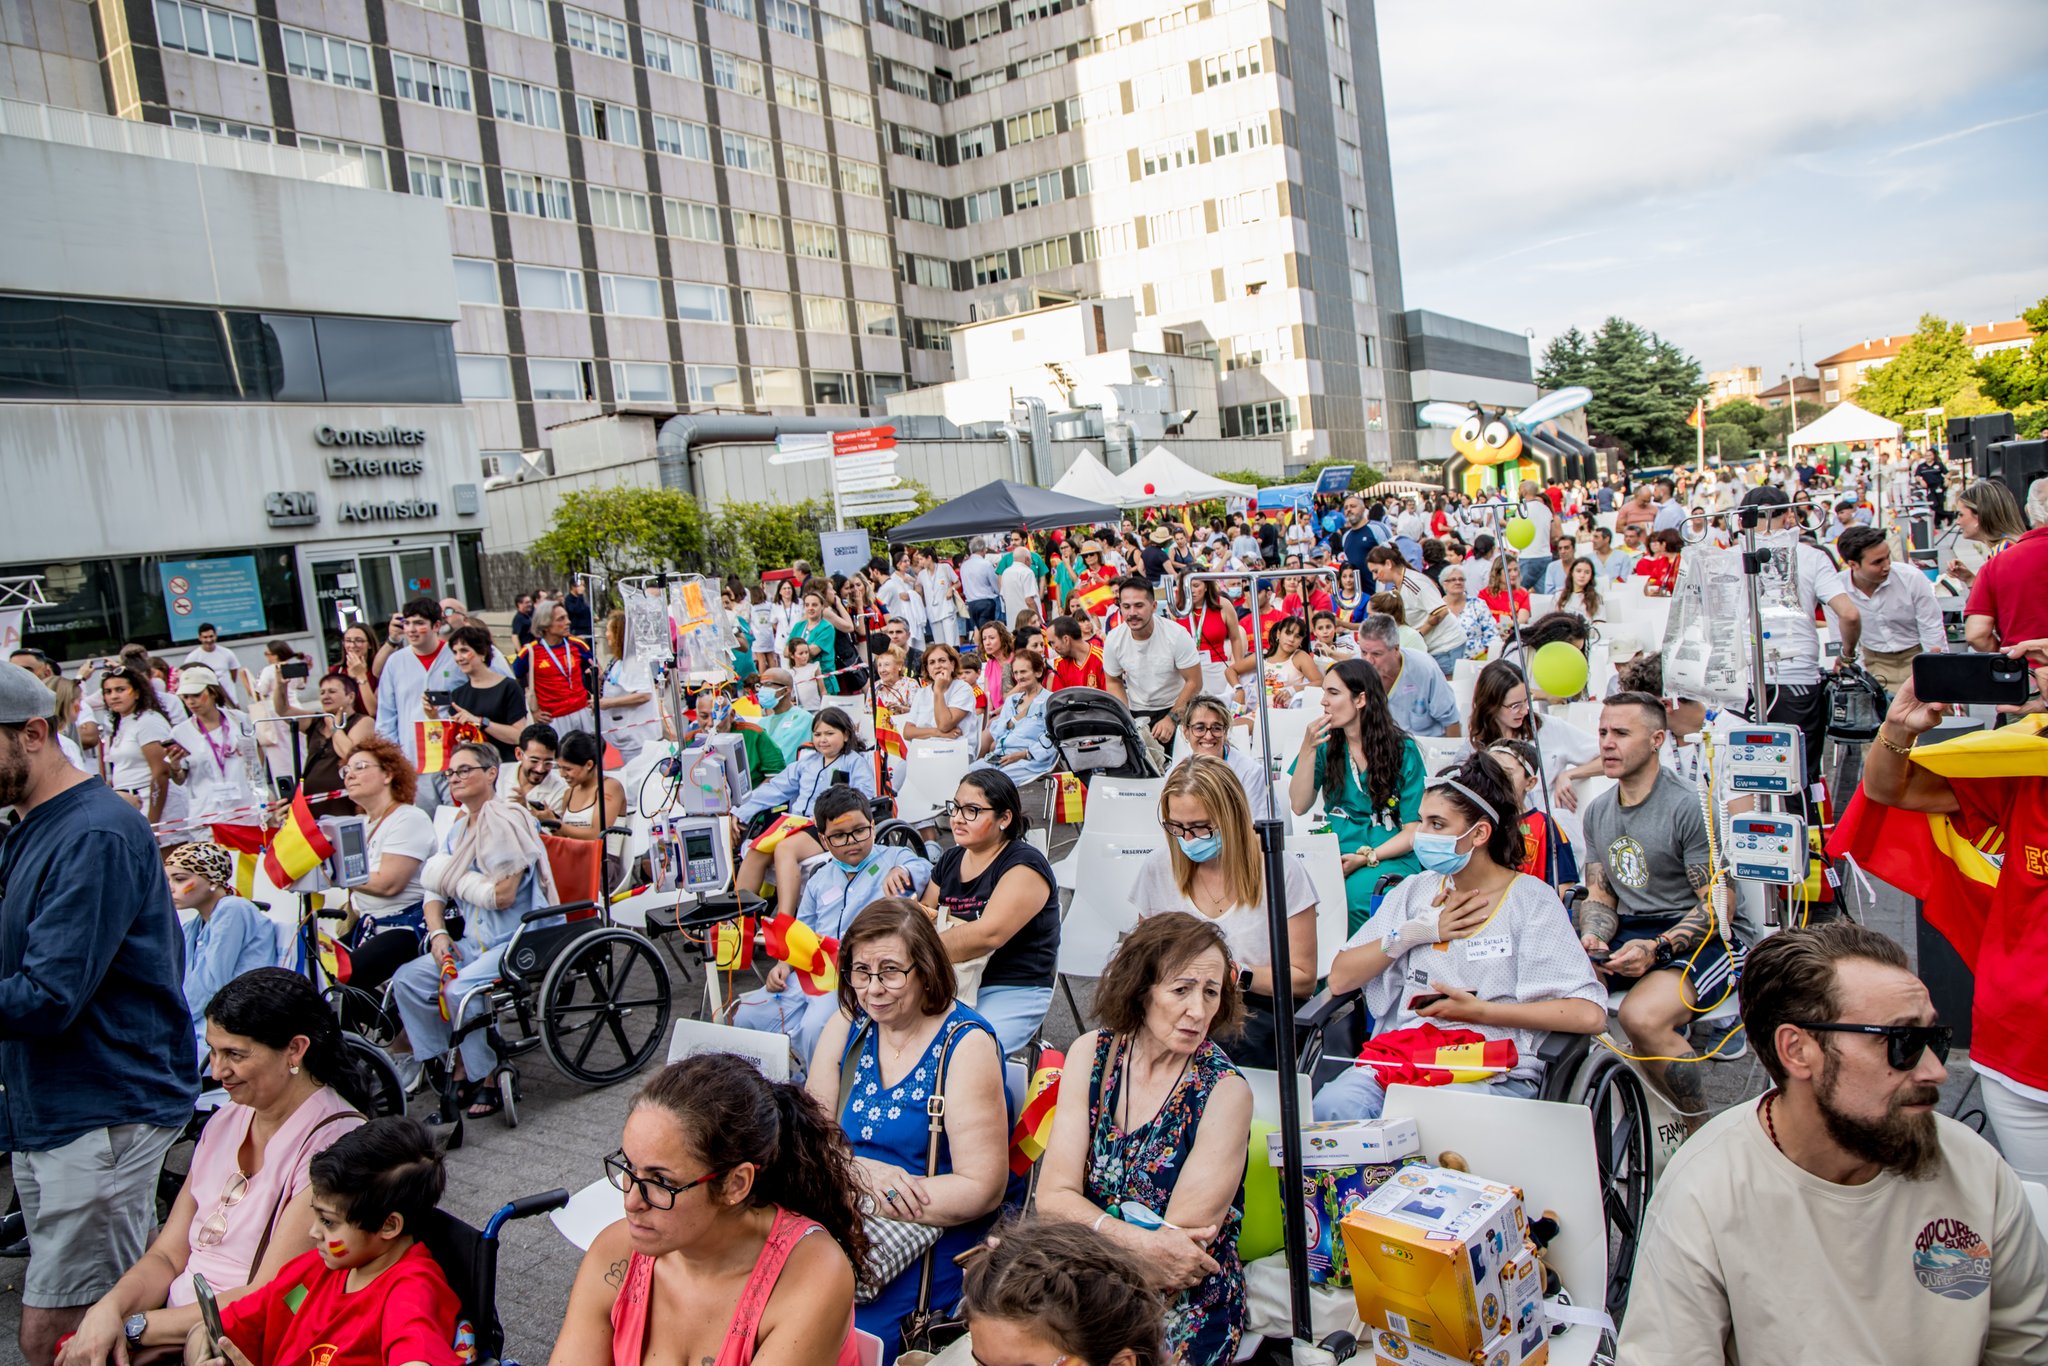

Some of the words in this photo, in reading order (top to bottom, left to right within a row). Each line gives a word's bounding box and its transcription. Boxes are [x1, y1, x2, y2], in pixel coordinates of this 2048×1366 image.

[314, 424, 426, 447] Consultas
[325, 457, 425, 479] Externas
[338, 498, 440, 523] Admisión
[1974, 1258, 1992, 1275] 69
